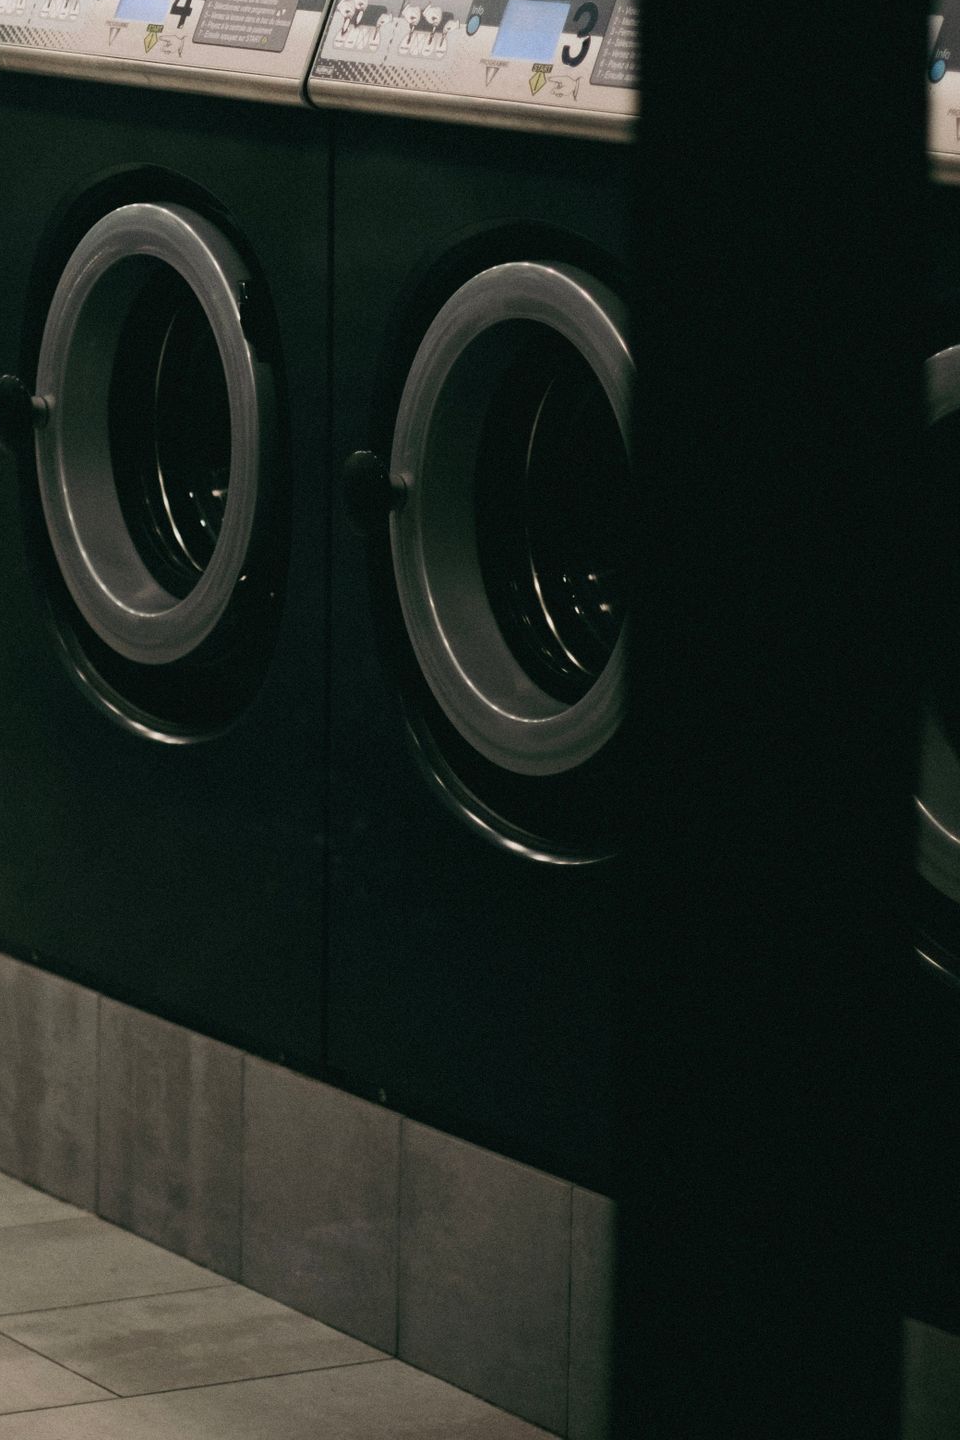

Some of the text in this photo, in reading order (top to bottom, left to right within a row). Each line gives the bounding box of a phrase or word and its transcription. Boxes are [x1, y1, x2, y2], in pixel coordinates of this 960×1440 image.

[472, 5, 484, 15] Info
[561, 2, 599, 67] 3
[935, 49, 951, 60] Info
[532, 64, 553, 73] START
